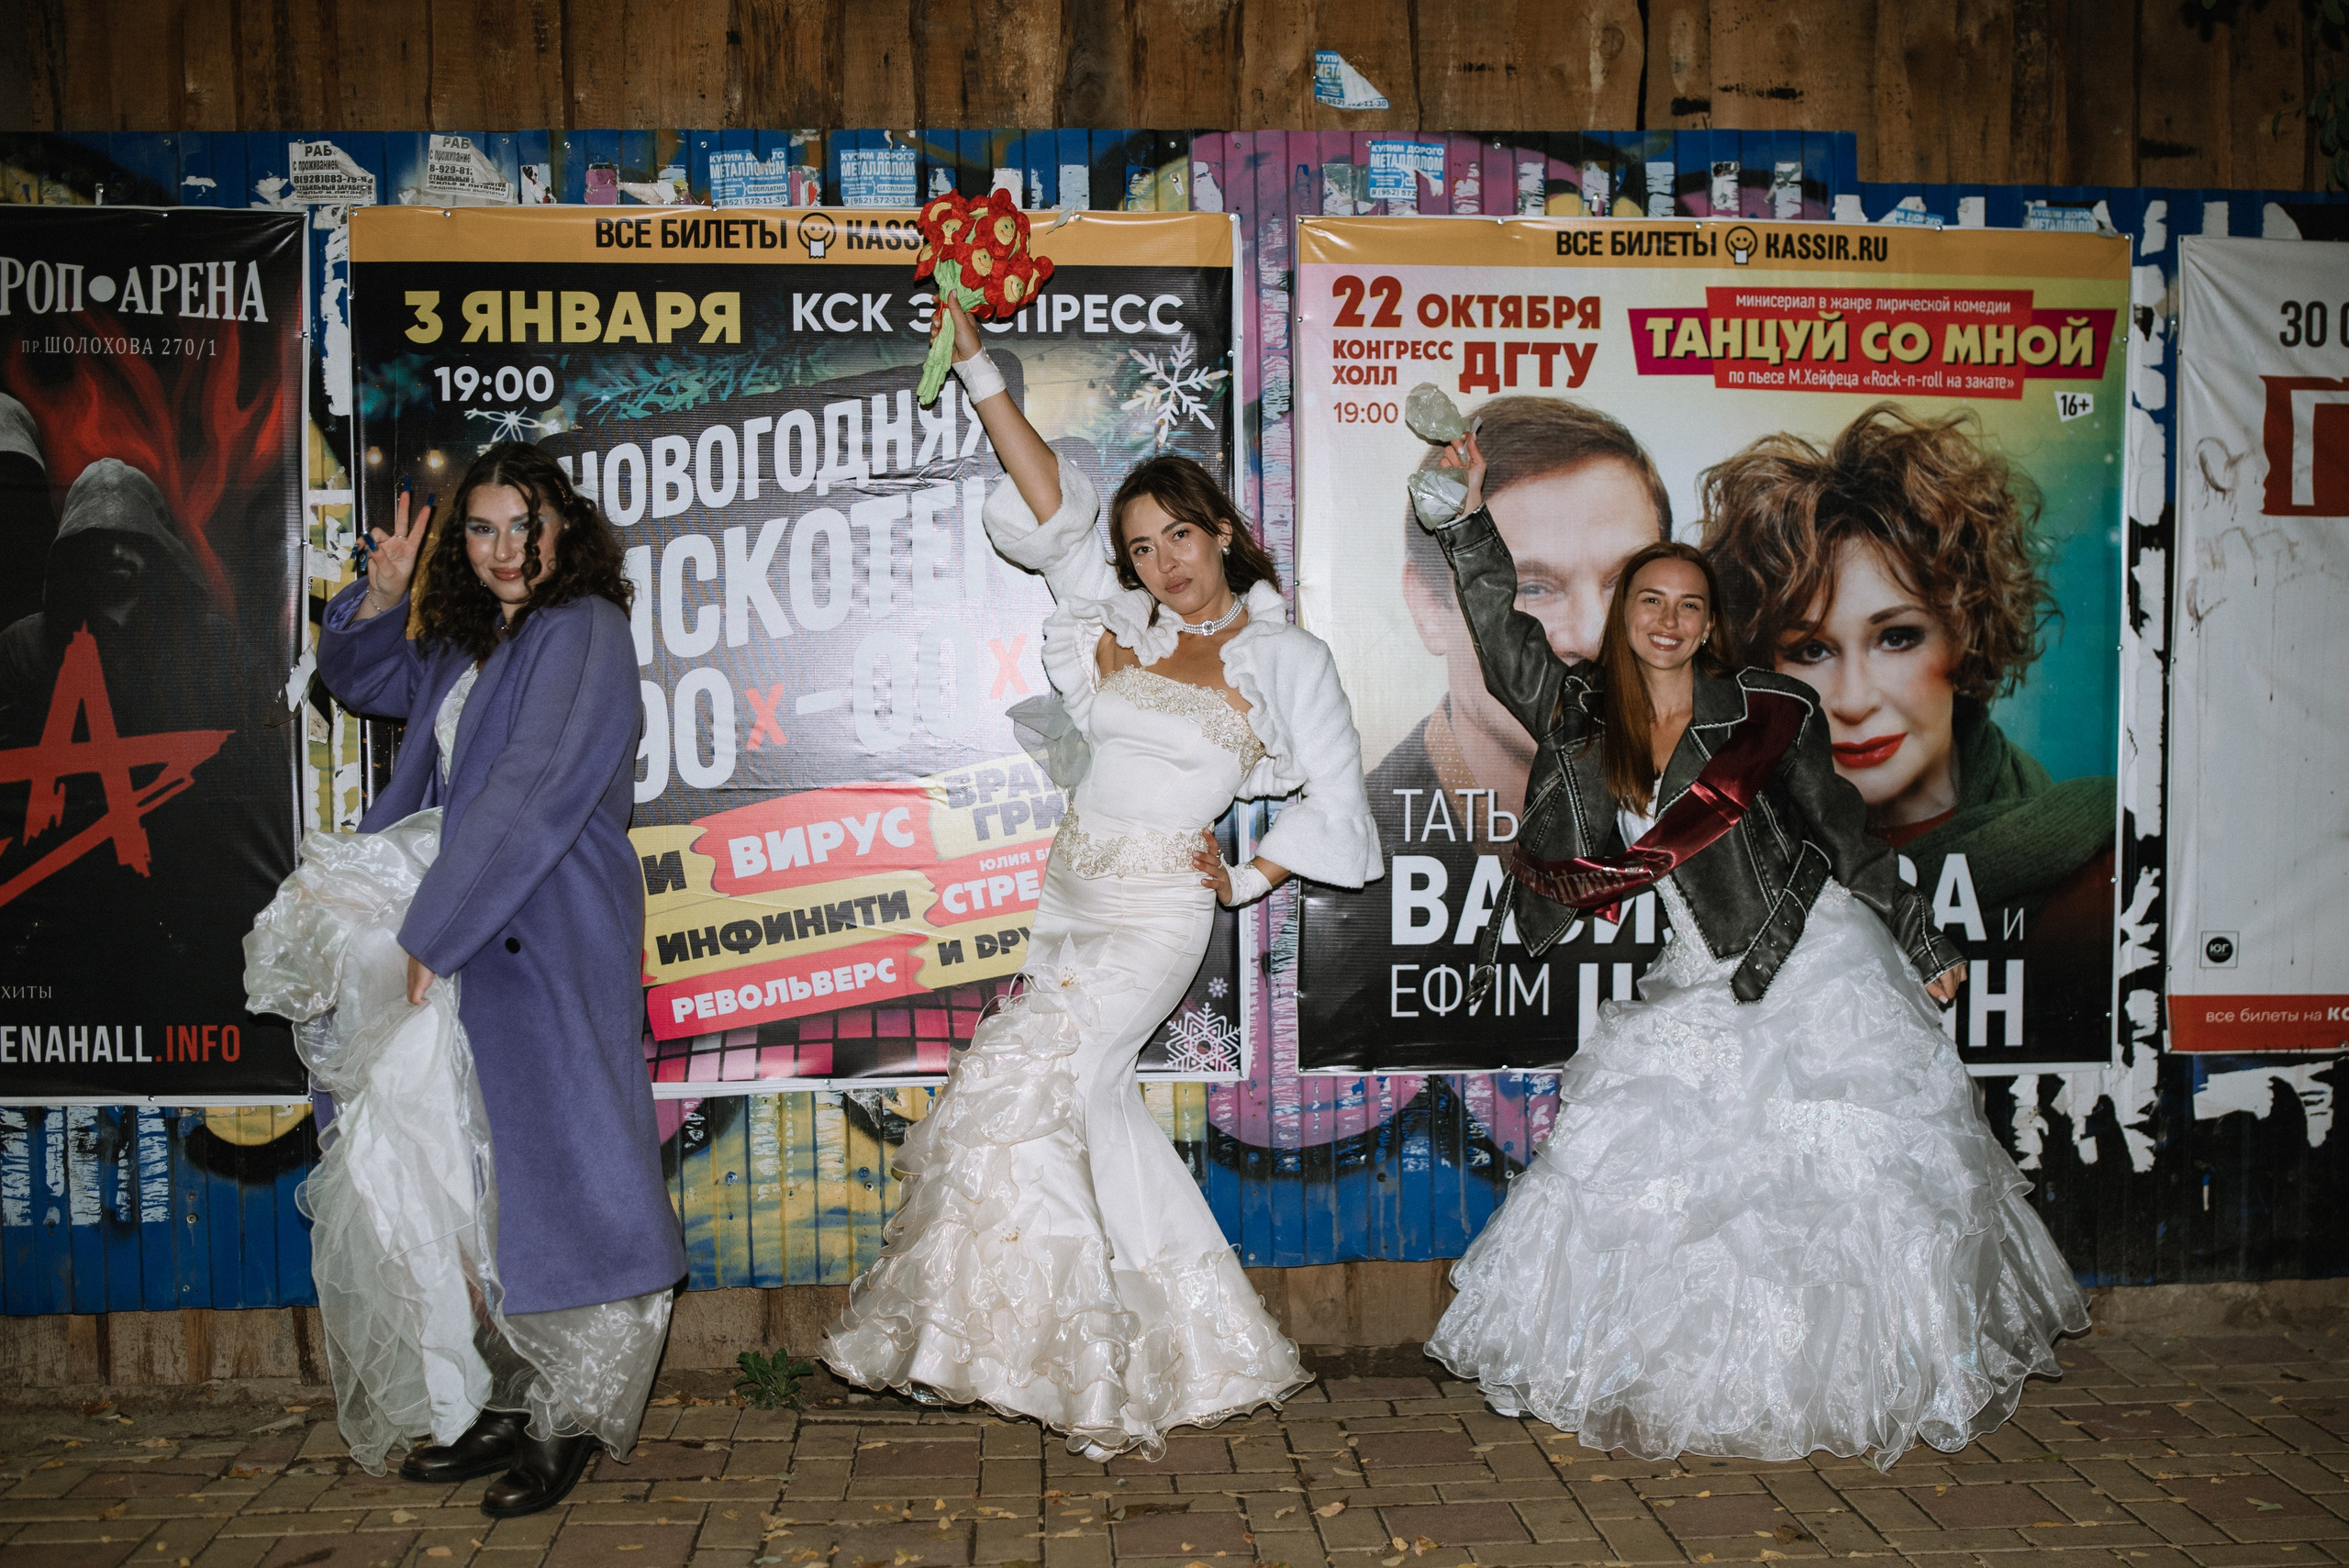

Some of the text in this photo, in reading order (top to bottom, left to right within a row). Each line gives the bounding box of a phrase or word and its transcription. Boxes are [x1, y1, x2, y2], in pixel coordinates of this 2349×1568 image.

[709, 153, 743, 163] КУПИМ
[841, 151, 915, 161] КУПИМ ДОРОГО
[1371, 144, 1444, 156] КУПИМ ДОРОГО
[841, 161, 916, 177] МЕТАЛЛОЛОМ
[1370, 153, 1443, 172] МЕТАЛЛОЛОМ
[745, 195, 786, 206] 572-11-30
[851, 196, 872, 206] (952)
[874, 196, 915, 205] 572-11-30
[1378, 188, 1399, 196] (952)
[595, 218, 651, 248] ВСЕ
[661, 218, 787, 249] БИЛЕТЫ
[1556, 230, 1888, 261] ВСЕ БИЛЕТЫ KASSIR.RU
[792, 292, 1185, 334] КСК ЭПРЕСС
[1332, 275, 1601, 329] 22 ОКТЯБРЯ
[1735, 295, 2010, 315] минисериал в жанре лирической комедии
[404, 290, 741, 344] 3 ЯНВАРЯ
[2279, 300, 2328, 348] 30
[161, 338, 217, 360] 270/1
[1644, 310, 2095, 367] ТАНЦУЙ СО МНОЙ
[1332, 339, 1453, 361] КОНГРЕСС
[1332, 365, 1397, 385] ХОЛЛ
[1458, 341, 1598, 395] ДГТУ
[1729, 371, 1744, 384] по
[1748, 371, 1785, 384] пьесе
[1789, 369, 1859, 389] М.Хейфеца
[1946, 375, 1962, 388] на
[1965, 375, 2015, 389] закате»
[434, 365, 554, 402] 19:00
[1333, 401, 1398, 424] 19:00
[2060, 395, 2089, 416] 16+
[972, 793, 1069, 841] ГРИ
[1392, 788, 1520, 842] ТАТЬ
[727, 807, 916, 879] ВИРУС
[979, 851, 1031, 872] ЮЛИЯ
[655, 889, 911, 965] ИНФИНИТИ
[937, 940, 964, 966] И
[1, 985, 52, 999] ХИТЫ
[672, 958, 896, 1024] РЕВОЛЬВЕРС
[1390, 963, 1550, 1018] ЕФИМ
[2205, 1010, 2235, 1023] все
[2240, 1007, 2299, 1023] билеты
[2303, 1011, 2322, 1022] на
